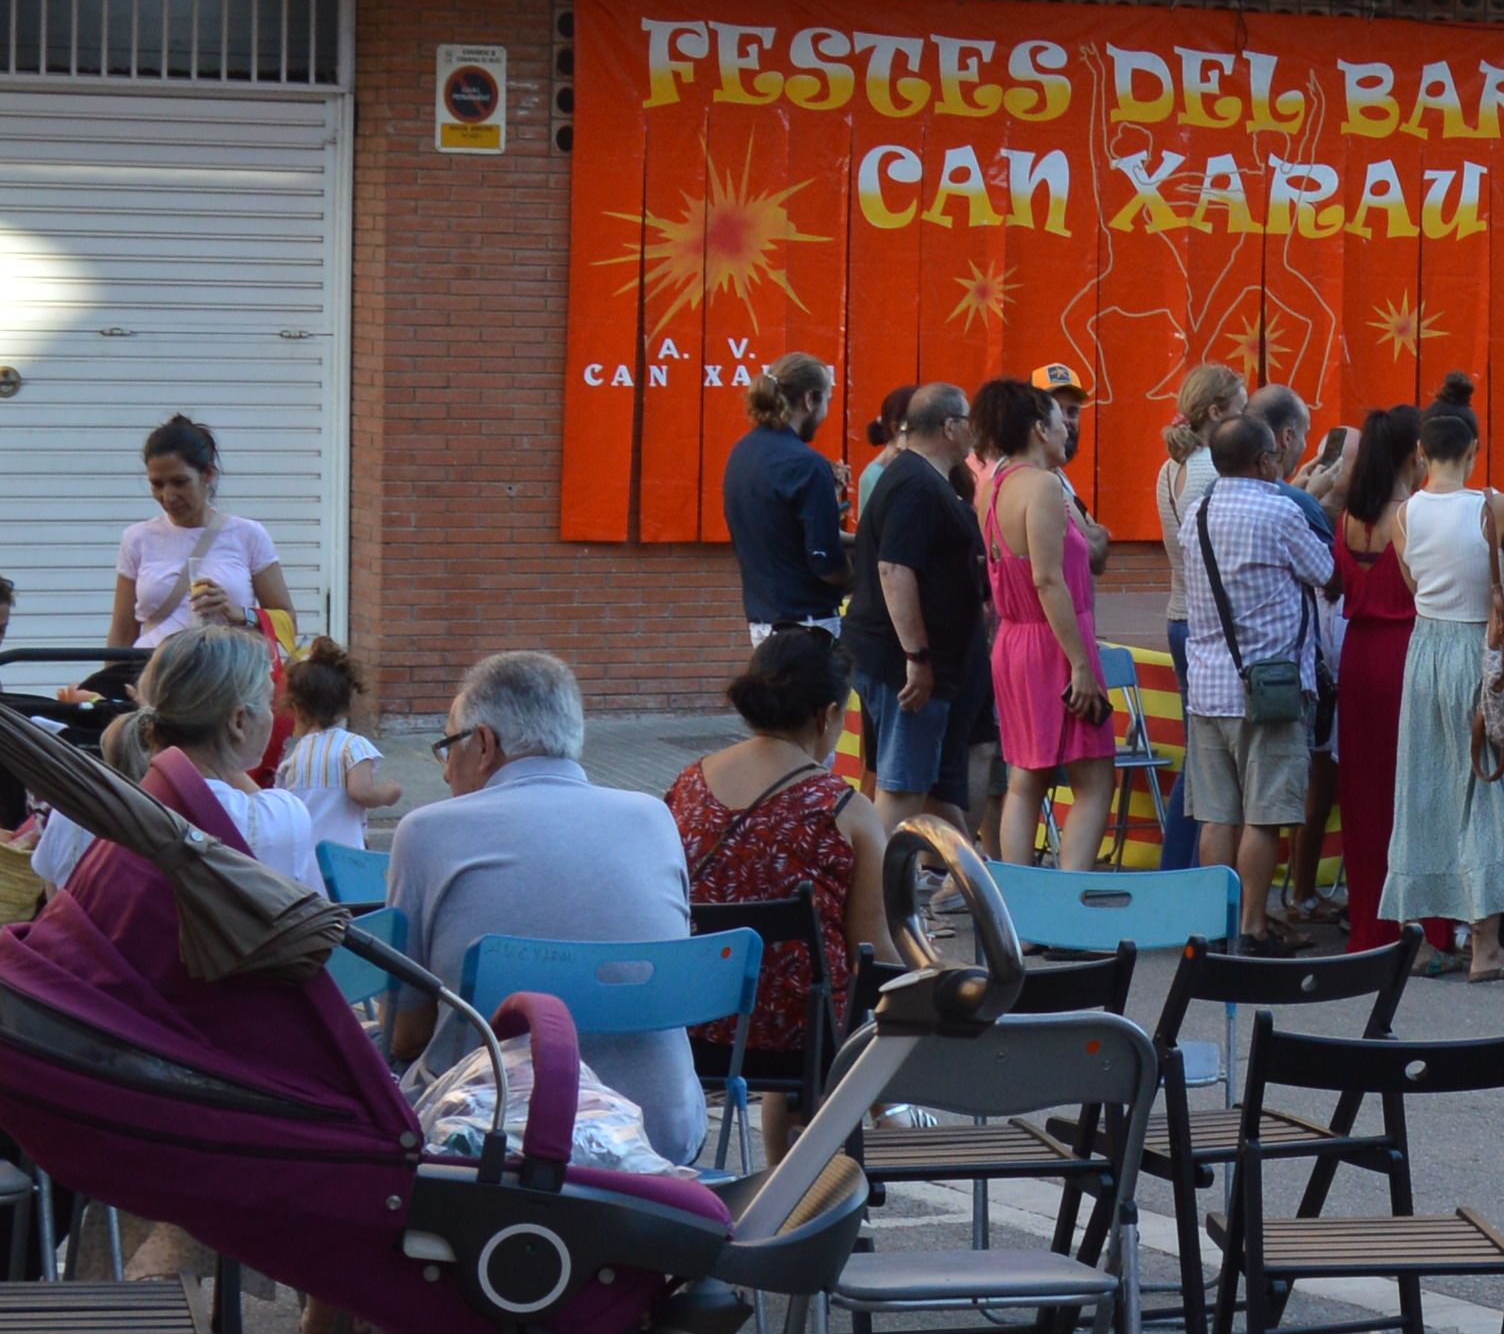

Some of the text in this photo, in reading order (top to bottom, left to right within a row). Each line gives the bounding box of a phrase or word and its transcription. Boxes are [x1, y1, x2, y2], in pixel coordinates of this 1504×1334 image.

[641, 18, 1073, 123] FESTES
[1106, 41, 1306, 136] DEL
[857, 143, 1490, 241] CAN XARAU
[583, 363, 668, 388] CAN
[657, 337, 757, 360] A. V.
